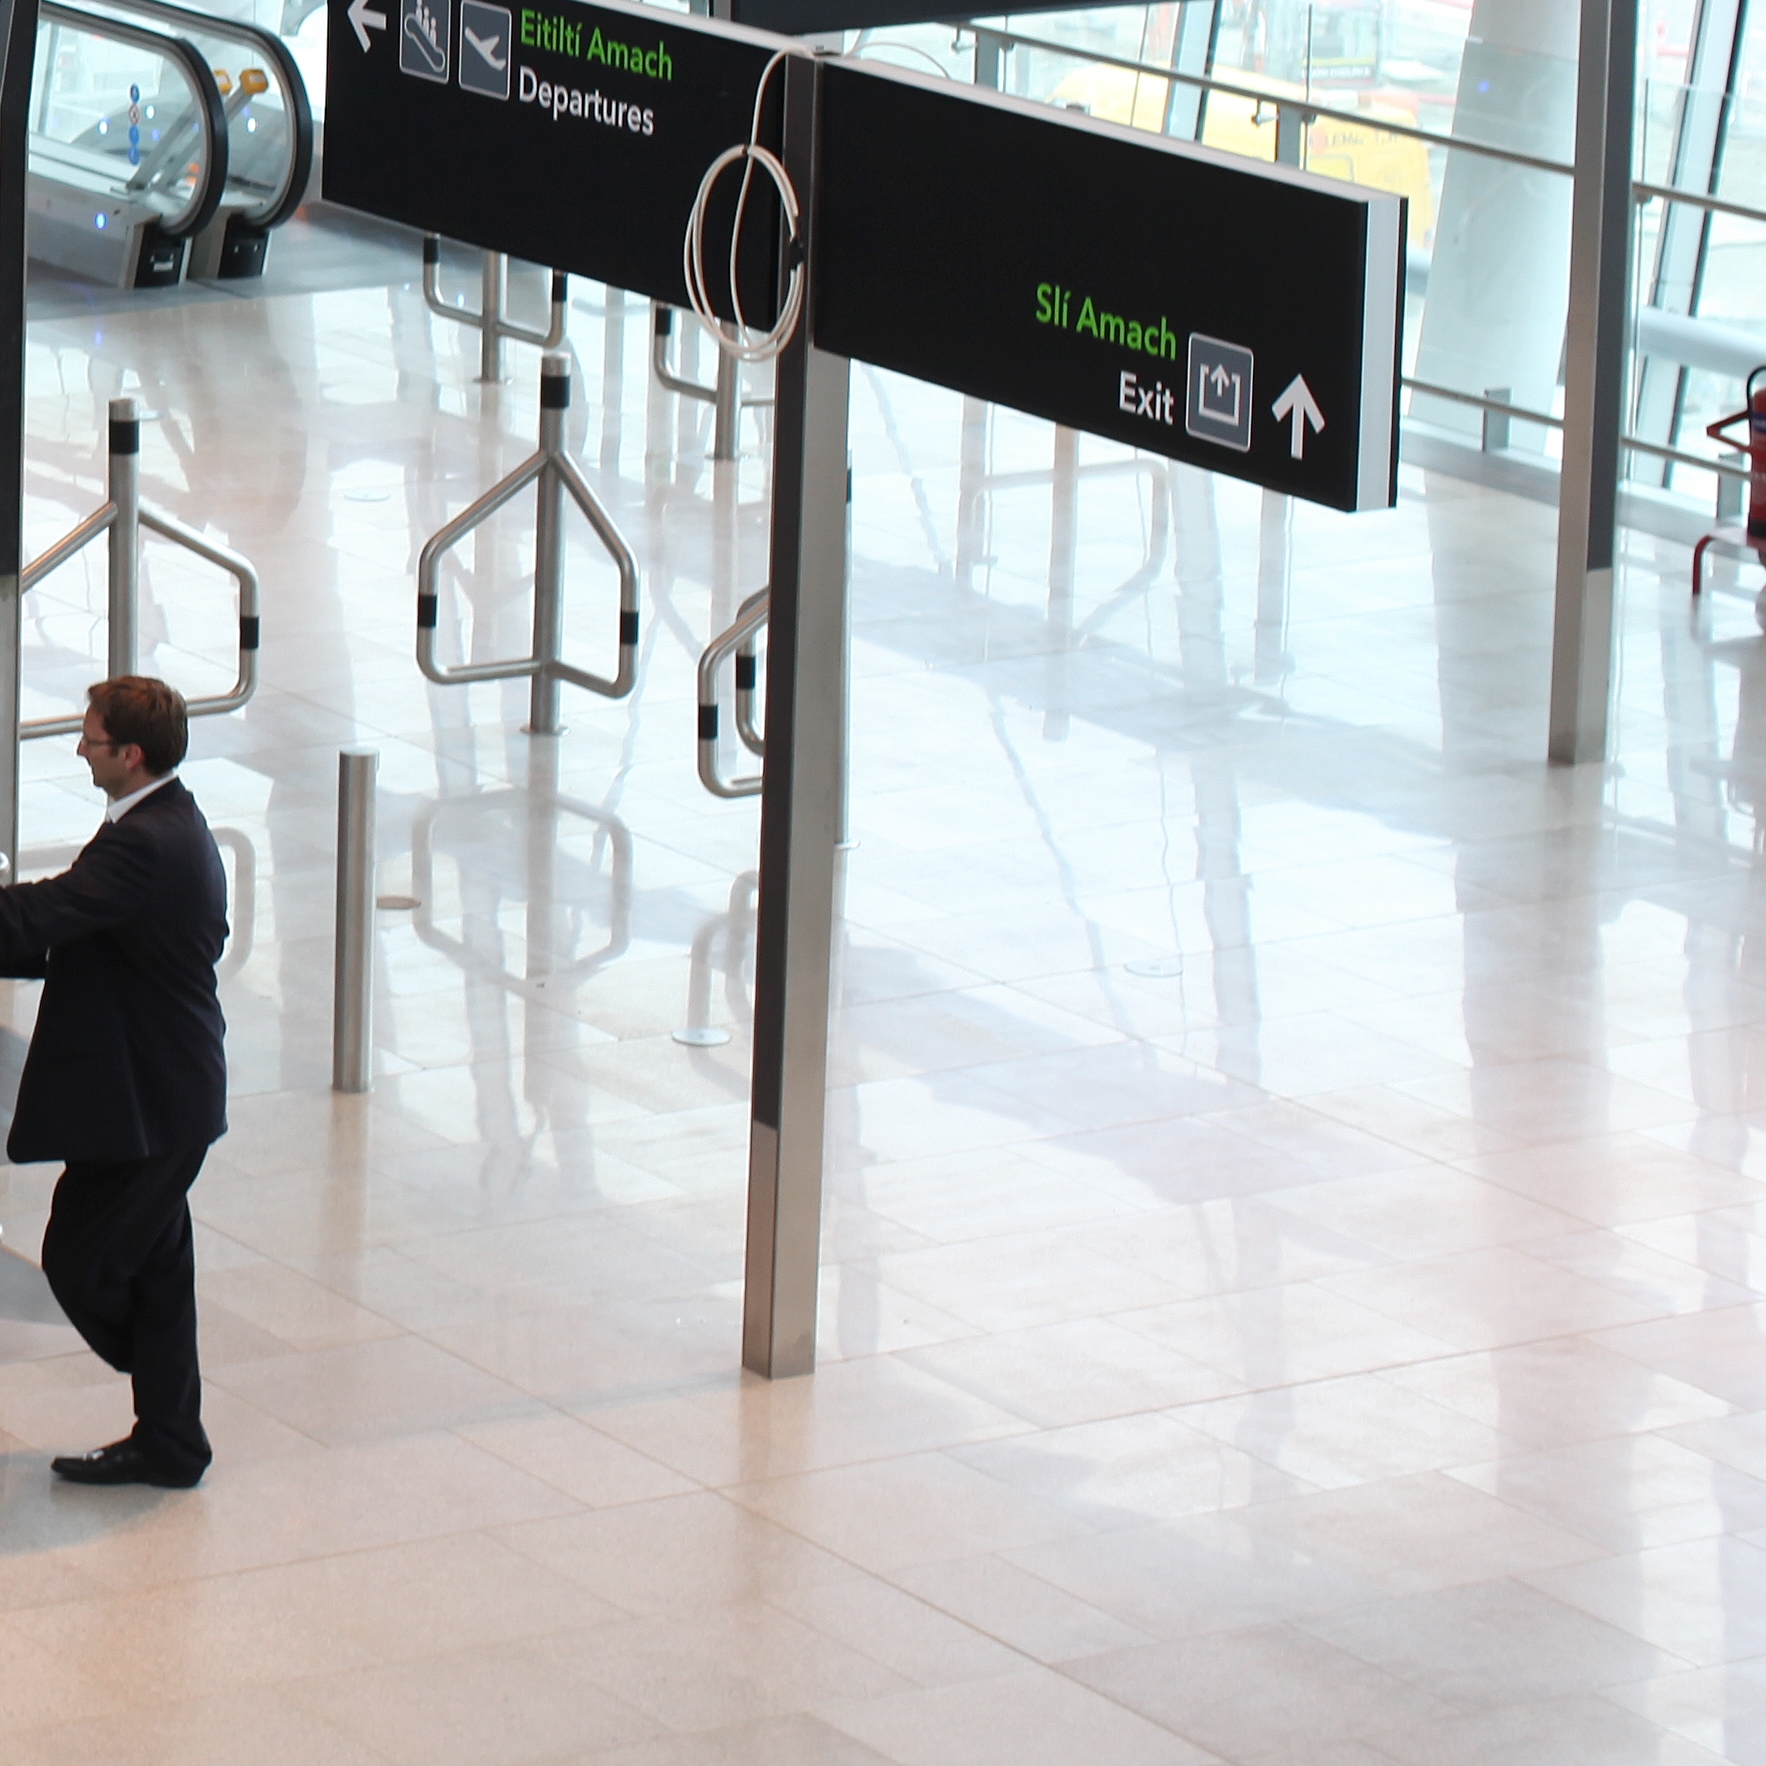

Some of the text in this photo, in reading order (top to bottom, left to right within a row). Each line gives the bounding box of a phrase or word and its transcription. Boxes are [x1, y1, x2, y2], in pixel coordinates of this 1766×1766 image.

[520, 9, 673, 80] Eitiltí Amach
[519, 65, 654, 136] Departures
[1035, 282, 1177, 360] Slí Amach
[1119, 371, 1174, 425] Exit
